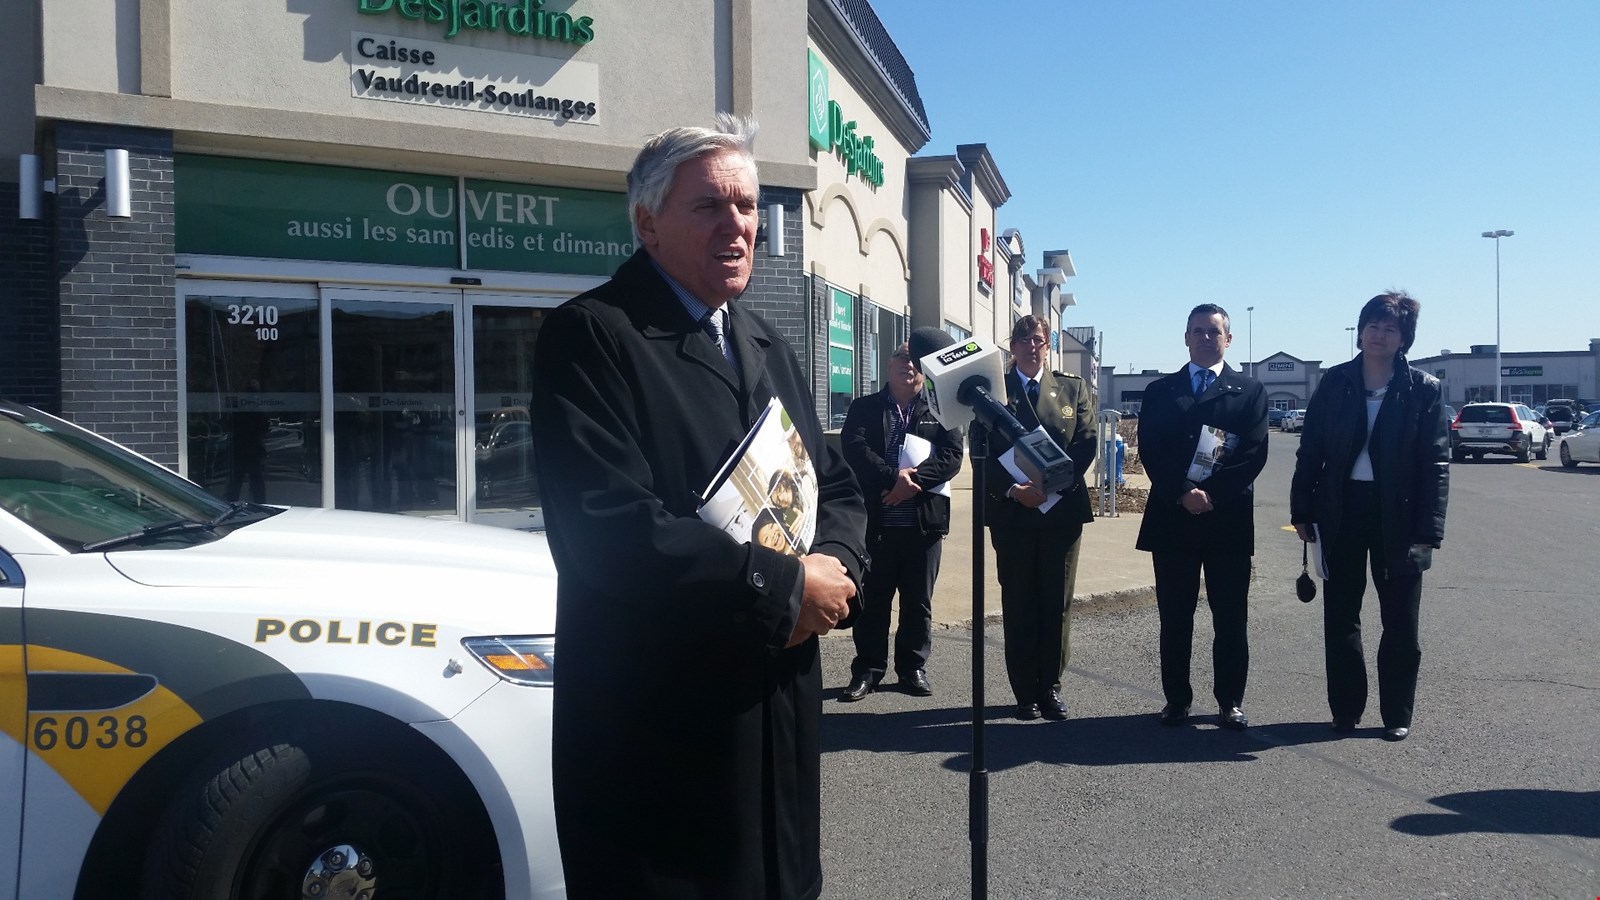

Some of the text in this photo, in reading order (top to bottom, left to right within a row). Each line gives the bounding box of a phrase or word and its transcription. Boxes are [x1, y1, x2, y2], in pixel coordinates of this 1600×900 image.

[357, 37, 435, 66] Caisse
[358, 68, 596, 119] Vaudreuil-Soulanges
[828, 100, 885, 186] Desjardins
[386, 183, 559, 226] OUVERT
[287, 217, 352, 239] aussi
[363, 218, 397, 242] les
[523, 232, 545, 251] et
[552, 232, 633, 257] dimanc
[227, 304, 279, 326] 3210
[255, 327, 279, 341] 100
[254, 617, 438, 648] POLICE
[33, 715, 148, 750] 6038
